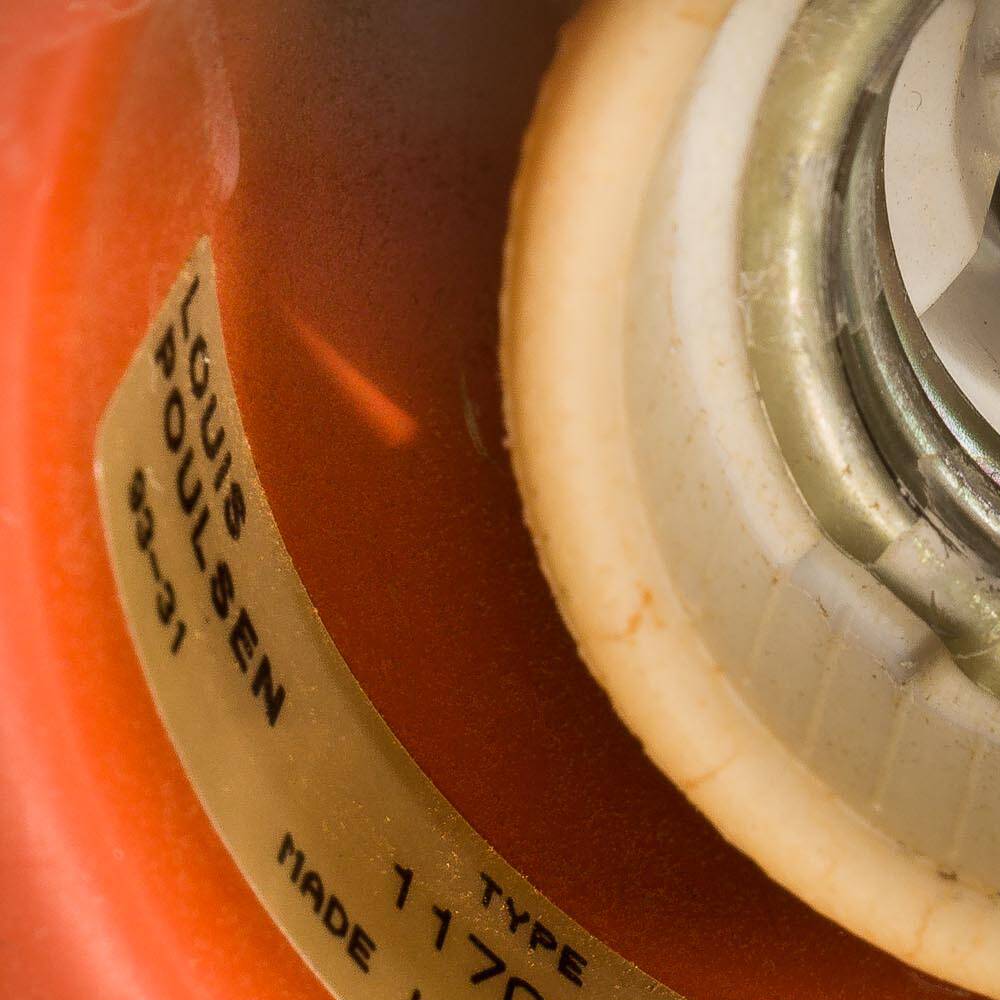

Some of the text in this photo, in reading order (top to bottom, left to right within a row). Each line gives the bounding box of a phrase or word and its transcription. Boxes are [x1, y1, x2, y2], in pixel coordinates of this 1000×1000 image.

[180, 274, 247, 541] LOUIS
[155, 323, 287, 728] POULSEN
[277, 832, 377, 974] MADE
[480, 871, 588, 988] TYPE
